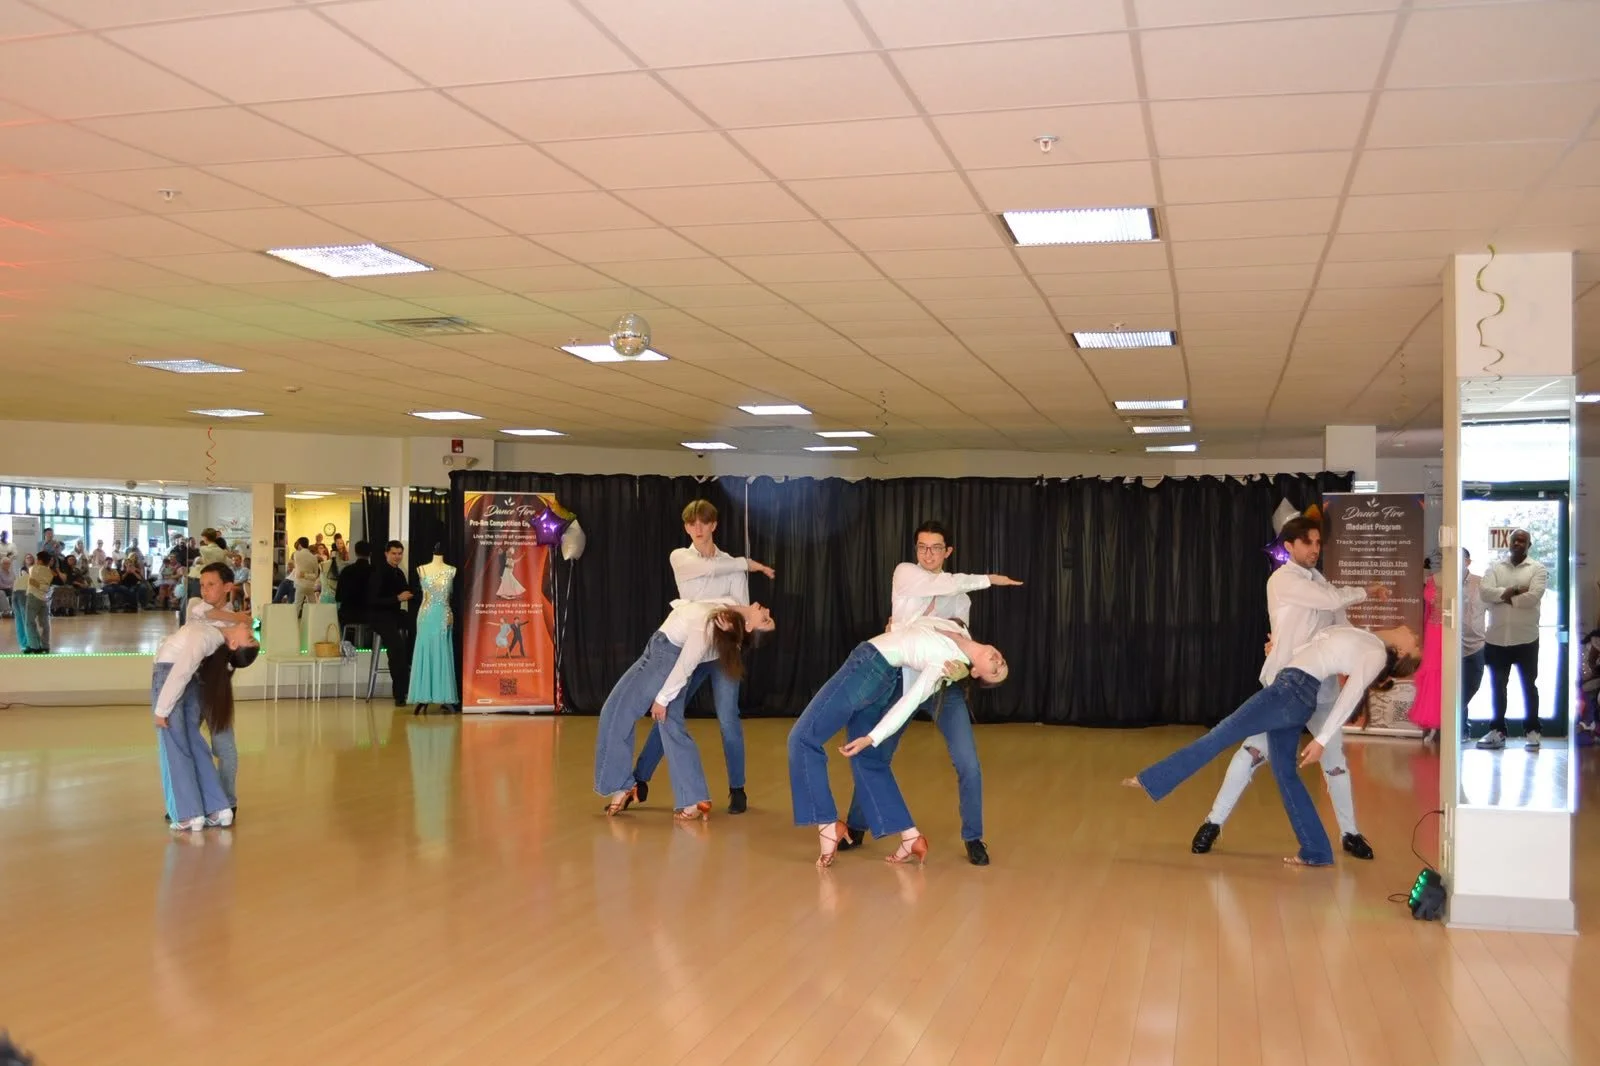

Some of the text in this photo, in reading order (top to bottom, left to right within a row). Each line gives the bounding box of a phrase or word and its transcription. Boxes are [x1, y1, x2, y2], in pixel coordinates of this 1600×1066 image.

[483, 505, 536, 517] Dance Fire
[1341, 506, 1405, 520] Dance Fire
[489, 519, 521, 528] Competition
[1345, 523, 1401, 532] Medalist Program
[1369, 559, 1379, 567] to
[1395, 559, 1408, 567] the
